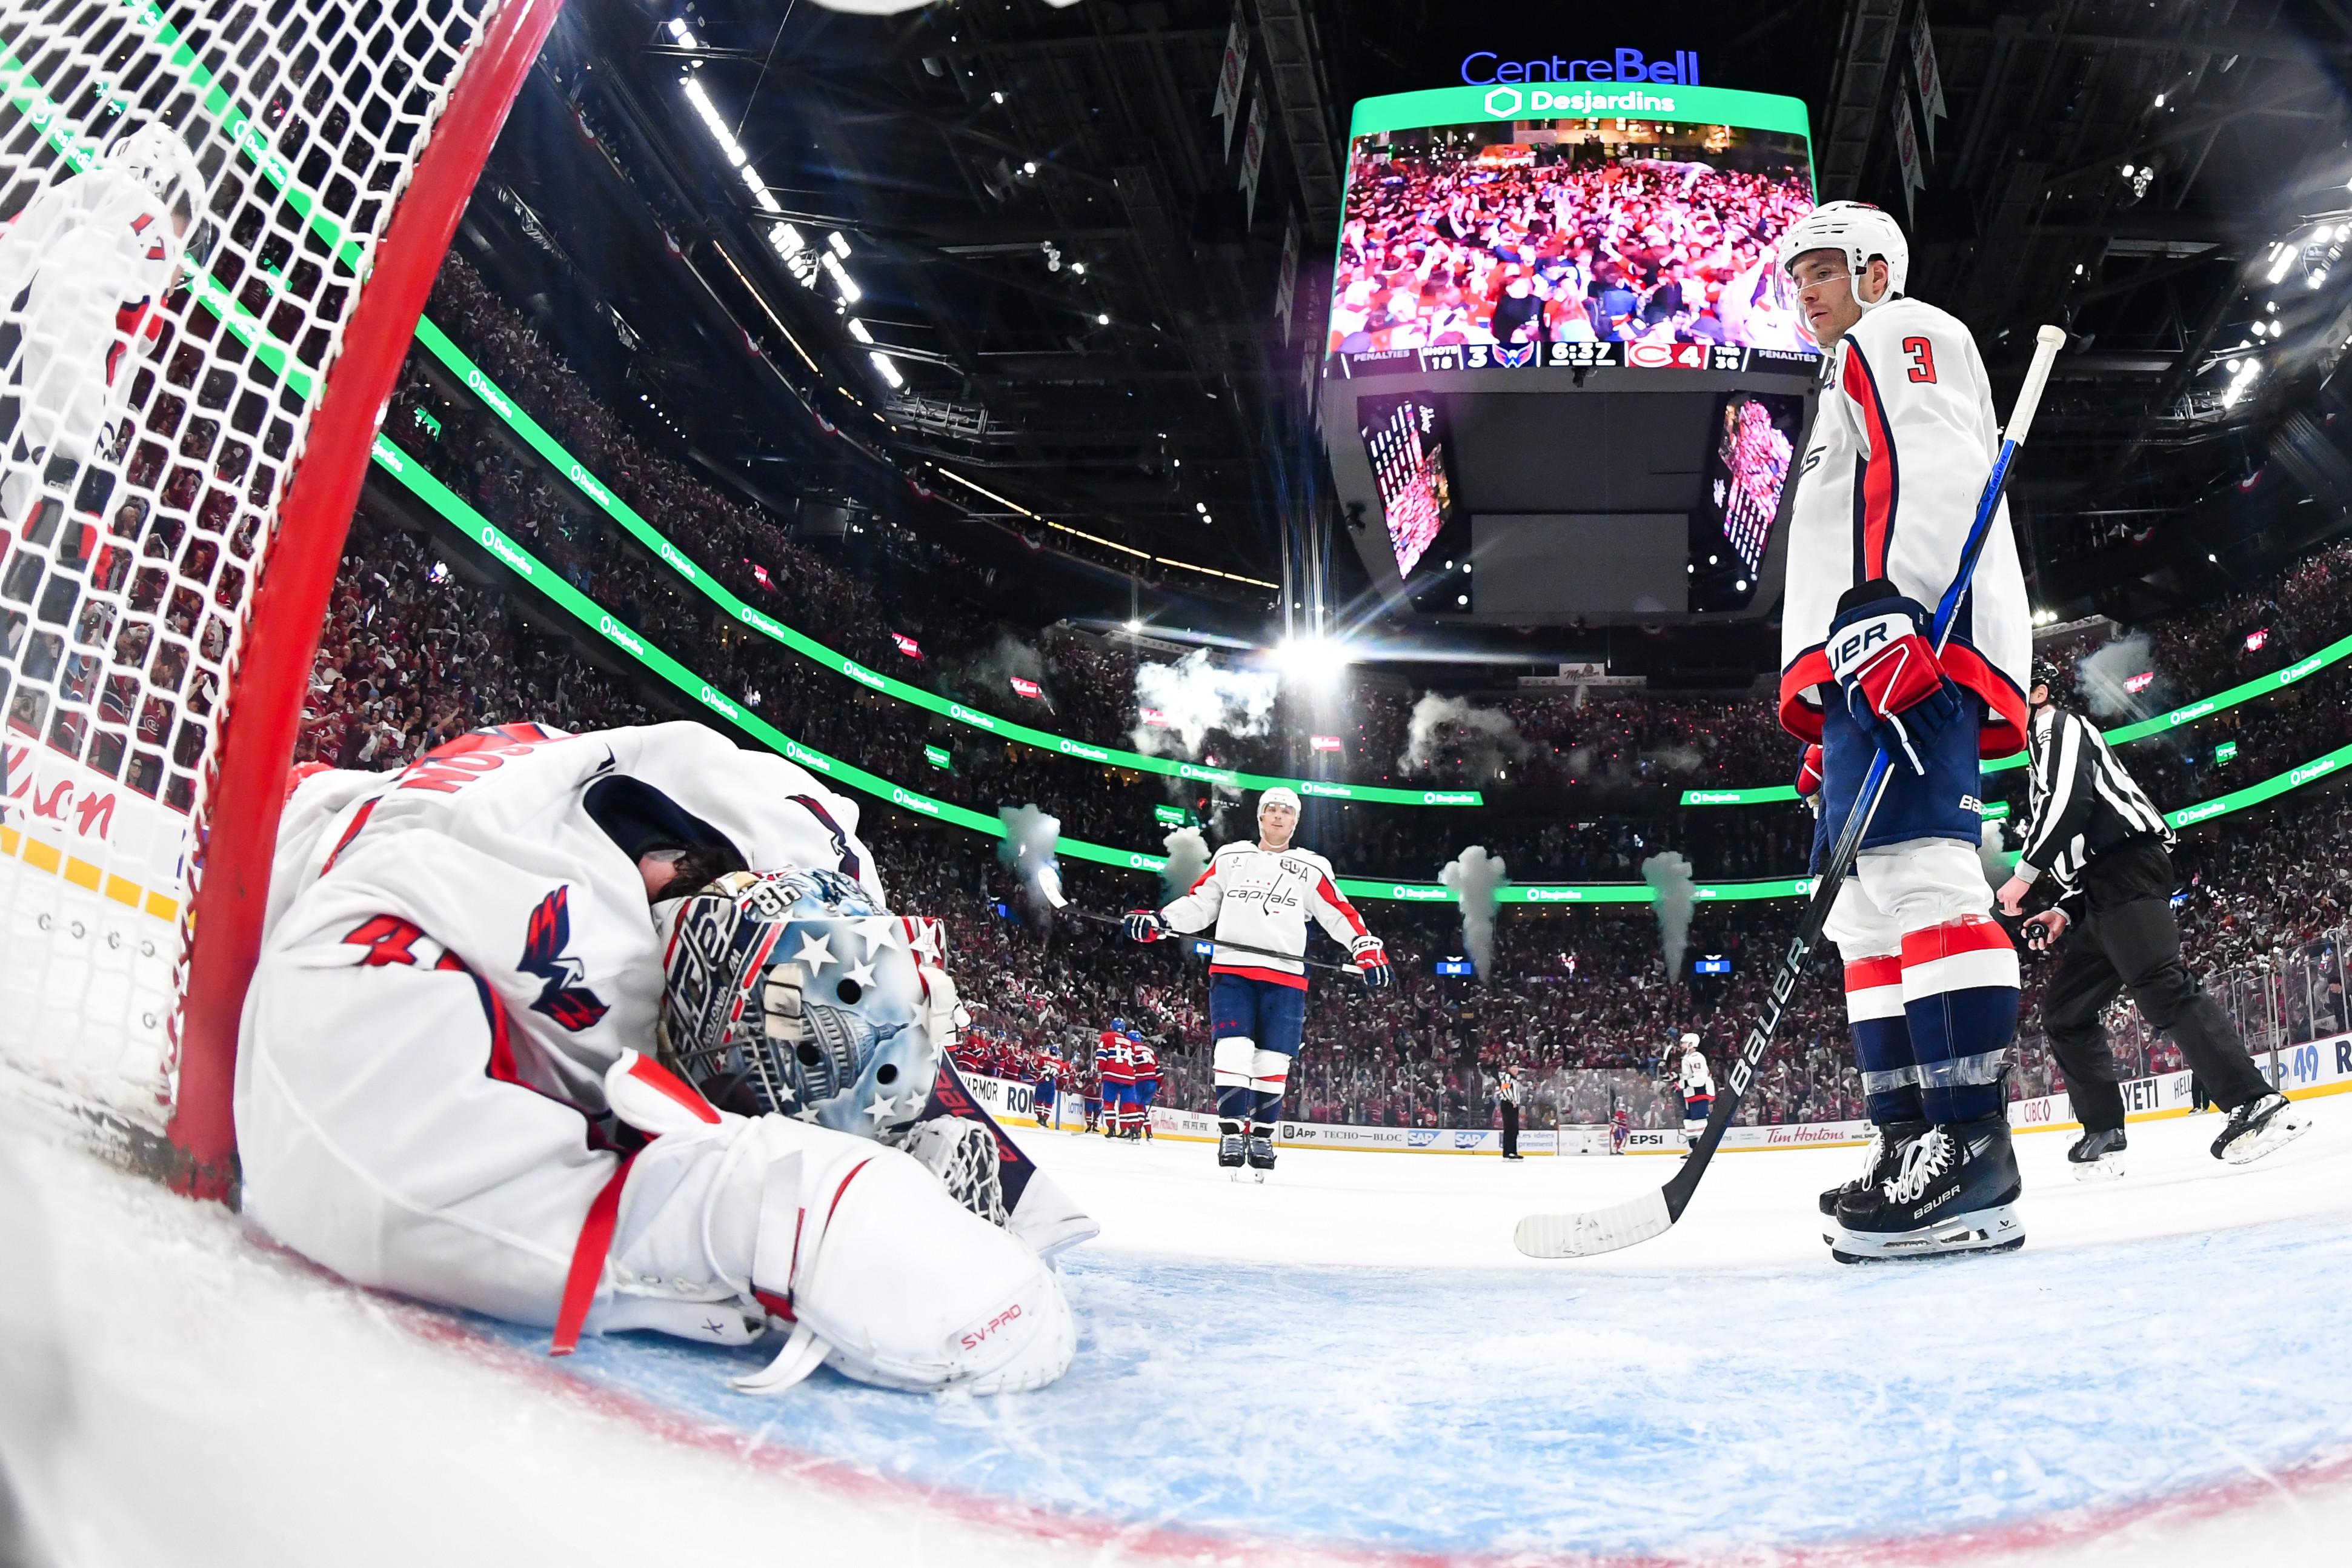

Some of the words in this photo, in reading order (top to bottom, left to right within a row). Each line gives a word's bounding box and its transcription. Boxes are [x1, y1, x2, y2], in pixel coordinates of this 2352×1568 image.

[1530, 90, 1676, 113] Desjardins
[1354, 349, 1410, 362] PENALTIES
[1467, 345, 1488, 368] 3
[1552, 342, 1612, 360] 6:37
[1679, 345, 1702, 368] 4
[1902, 337, 1938, 385] 3
[1431, 356, 1453, 370] 18
[1715, 356, 1739, 370] 36
[479, 380, 513, 418] Desjardins
[580, 474, 610, 506] Desjardins
[494, 537, 533, 575] Desjardins
[669, 550, 696, 578] Desjardins
[752, 614, 785, 638] Desjardins
[611, 624, 643, 656] Desjardins
[852, 667, 885, 688] Desjardins
[2291, 659, 2322, 678] Desjardins
[710, 693, 738, 719] Desjardins
[2181, 703, 2214, 720] Desjardins
[960, 709, 994, 728] Desjardins
[796, 748, 830, 771] Desjardins
[1071, 744, 1108, 760] Desjardins
[2301, 760, 2335, 780] Desjardins
[1313, 785, 1351, 796] Desjardins
[903, 794, 938, 814] Desjardins
[2188, 803, 2226, 820] Desjardins
[1298, 867, 1308, 883] A
[1729, 936, 1810, 1098] BAUER
[1114, 1044, 1135, 1067] 14
[1006, 1086, 1036, 1114] RON
[2122, 1078, 2159, 1112] YETI
[2024, 1100, 2042, 1123] CIBC
[1408, 1132, 1435, 1146] SAP
[1455, 1134, 1483, 1147] SAP
[1630, 1135, 1664, 1144] EPSI
[1766, 1128, 1790, 1143] Tim
[1793, 1126, 1844, 1142] Hortons
[1913, 1184, 1961, 1220] BAUER
[960, 1303, 1022, 1351] SV-PRO
